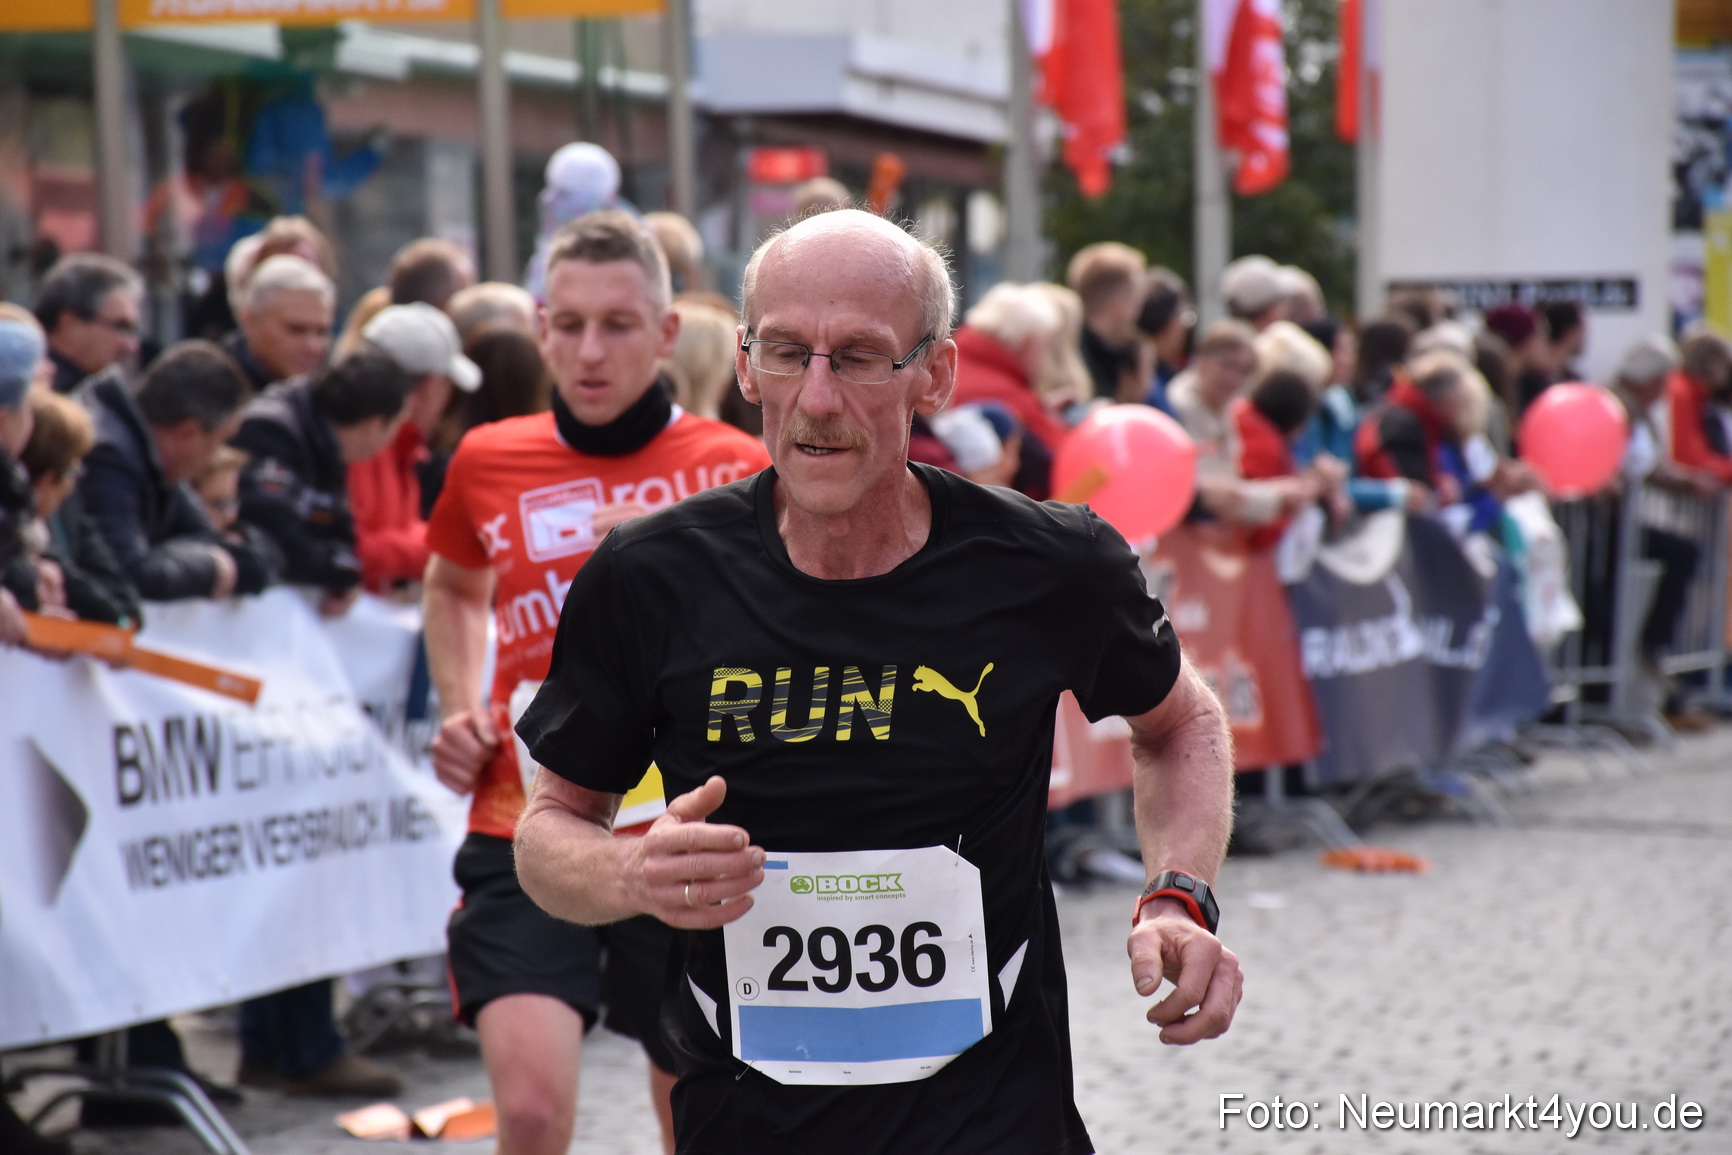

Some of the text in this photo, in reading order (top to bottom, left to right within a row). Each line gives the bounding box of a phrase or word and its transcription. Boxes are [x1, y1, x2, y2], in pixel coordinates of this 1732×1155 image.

[707, 665, 897, 743] RUN
[113, 711, 221, 807] BMW
[119, 822, 246, 893] WENIGER
[816, 873, 905, 895] BOCK
[816, 892, 906, 902] inspired by smart concepts
[743, 982, 752, 995] D
[763, 921, 947, 994] 2936
